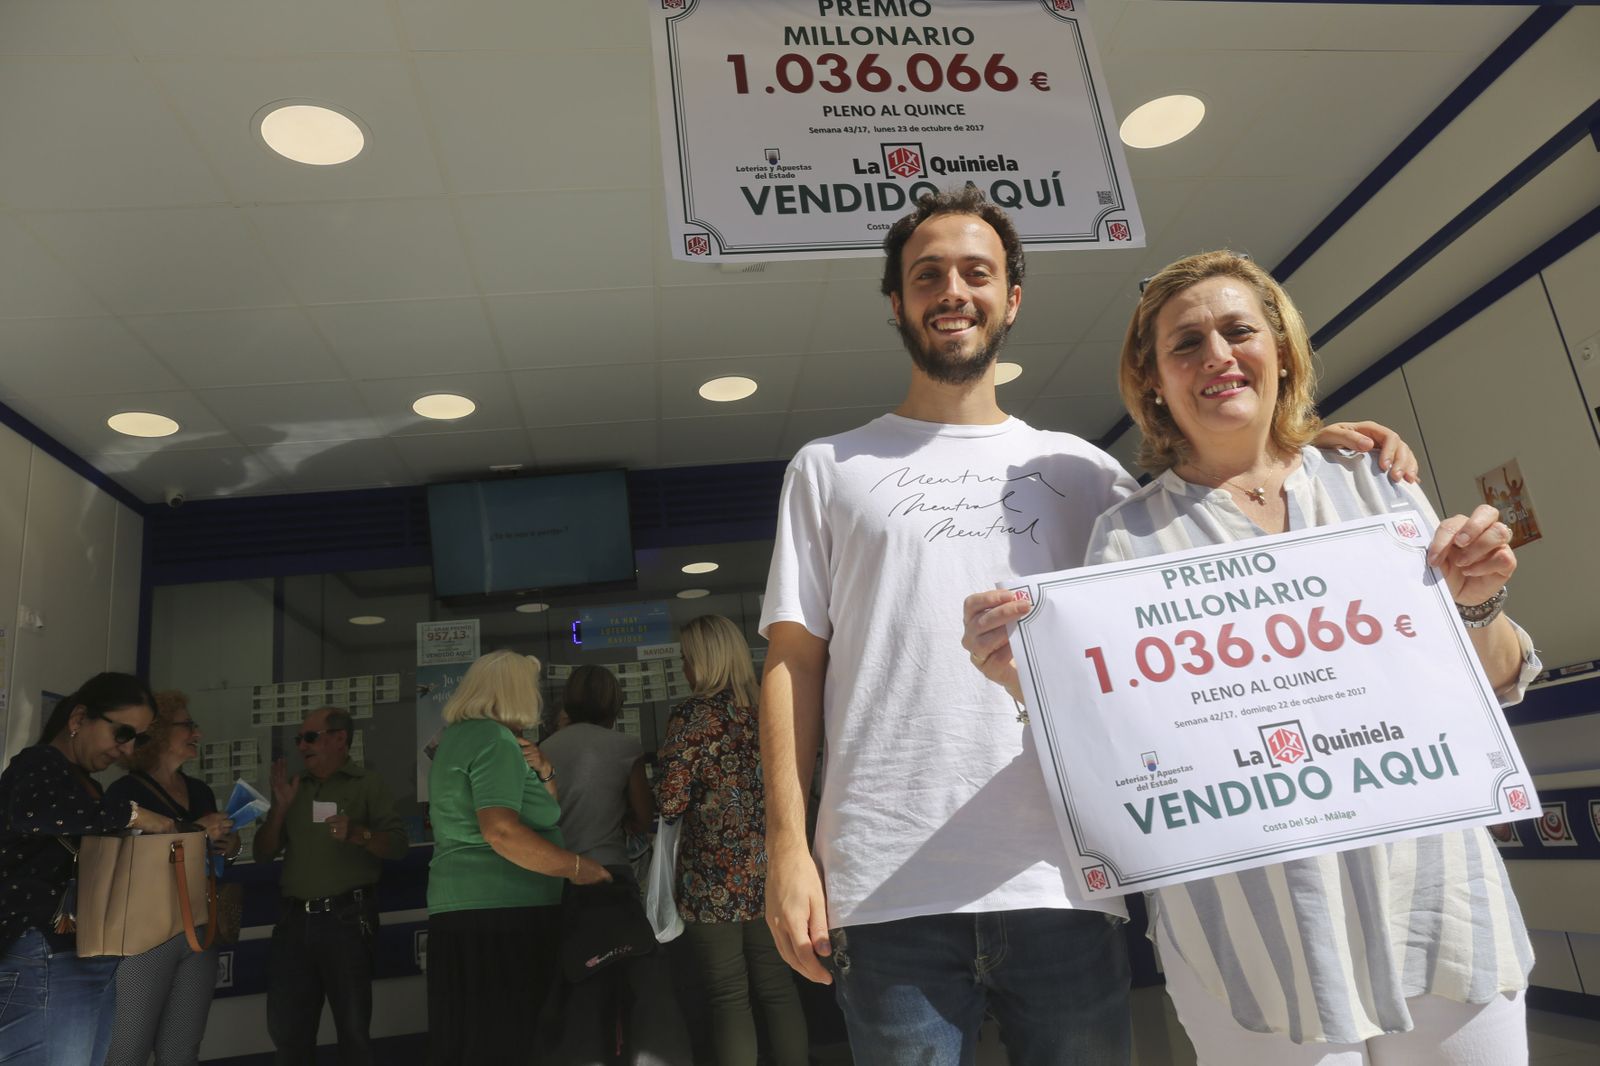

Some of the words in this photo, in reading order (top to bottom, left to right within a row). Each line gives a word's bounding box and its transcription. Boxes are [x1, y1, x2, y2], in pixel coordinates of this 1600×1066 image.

[819, 0, 931, 17] PREMIO
[784, 25, 975, 46] MILLONARIO
[727, 52, 1019, 95] 1.036.066
[1029, 71, 1051, 92] €
[822, 105, 876, 117] PLENO
[880, 104, 901, 116] AL
[904, 103, 966, 117] QUINCE
[874, 125, 896, 133] lunes
[921, 124, 952, 132] octubre
[954, 124, 964, 132] de
[965, 124, 984, 132] 2017
[776, 164, 812, 173] Apuestas
[852, 158, 881, 175] La
[929, 154, 1019, 176] Quiniela
[866, 223, 890, 231] Costa
[888, 490, 1023, 517] Neutral
[924, 516, 1040, 545] Neutral
[1160, 552, 1277, 590] PREMIO
[1134, 575, 1328, 629] MILLONARIO
[643, 647, 674, 656] NAVIDAD
[1084, 599, 1383, 694] 1.036.066
[1393, 613, 1417, 638] €
[1190, 683, 1245, 705] PLENO
[1250, 679, 1271, 695] AL
[1273, 666, 1337, 691] QUINCE
[1174, 716, 1208, 729] Semana
[1240, 703, 1277, 716] domingo
[1278, 701, 1289, 709] 22
[1290, 699, 1301, 707] de
[1302, 693, 1334, 705] octubre
[1335, 690, 1346, 699] de
[1347, 686, 1367, 697] 2017
[1233, 748, 1264, 768] La
[1311, 720, 1405, 756] Quiniela
[1156, 764, 1194, 779] Apuestas
[1123, 765, 1333, 835] VENDIDO
[1352, 733, 1460, 793] AQUÍ
[1136, 782, 1150, 792] del
[1150, 777, 1178, 789] Estado
[1262, 819, 1288, 833] Costa
[1288, 818, 1304, 829] Del
[1304, 815, 1319, 826] Sol
[1324, 809, 1357, 823] Málaga
